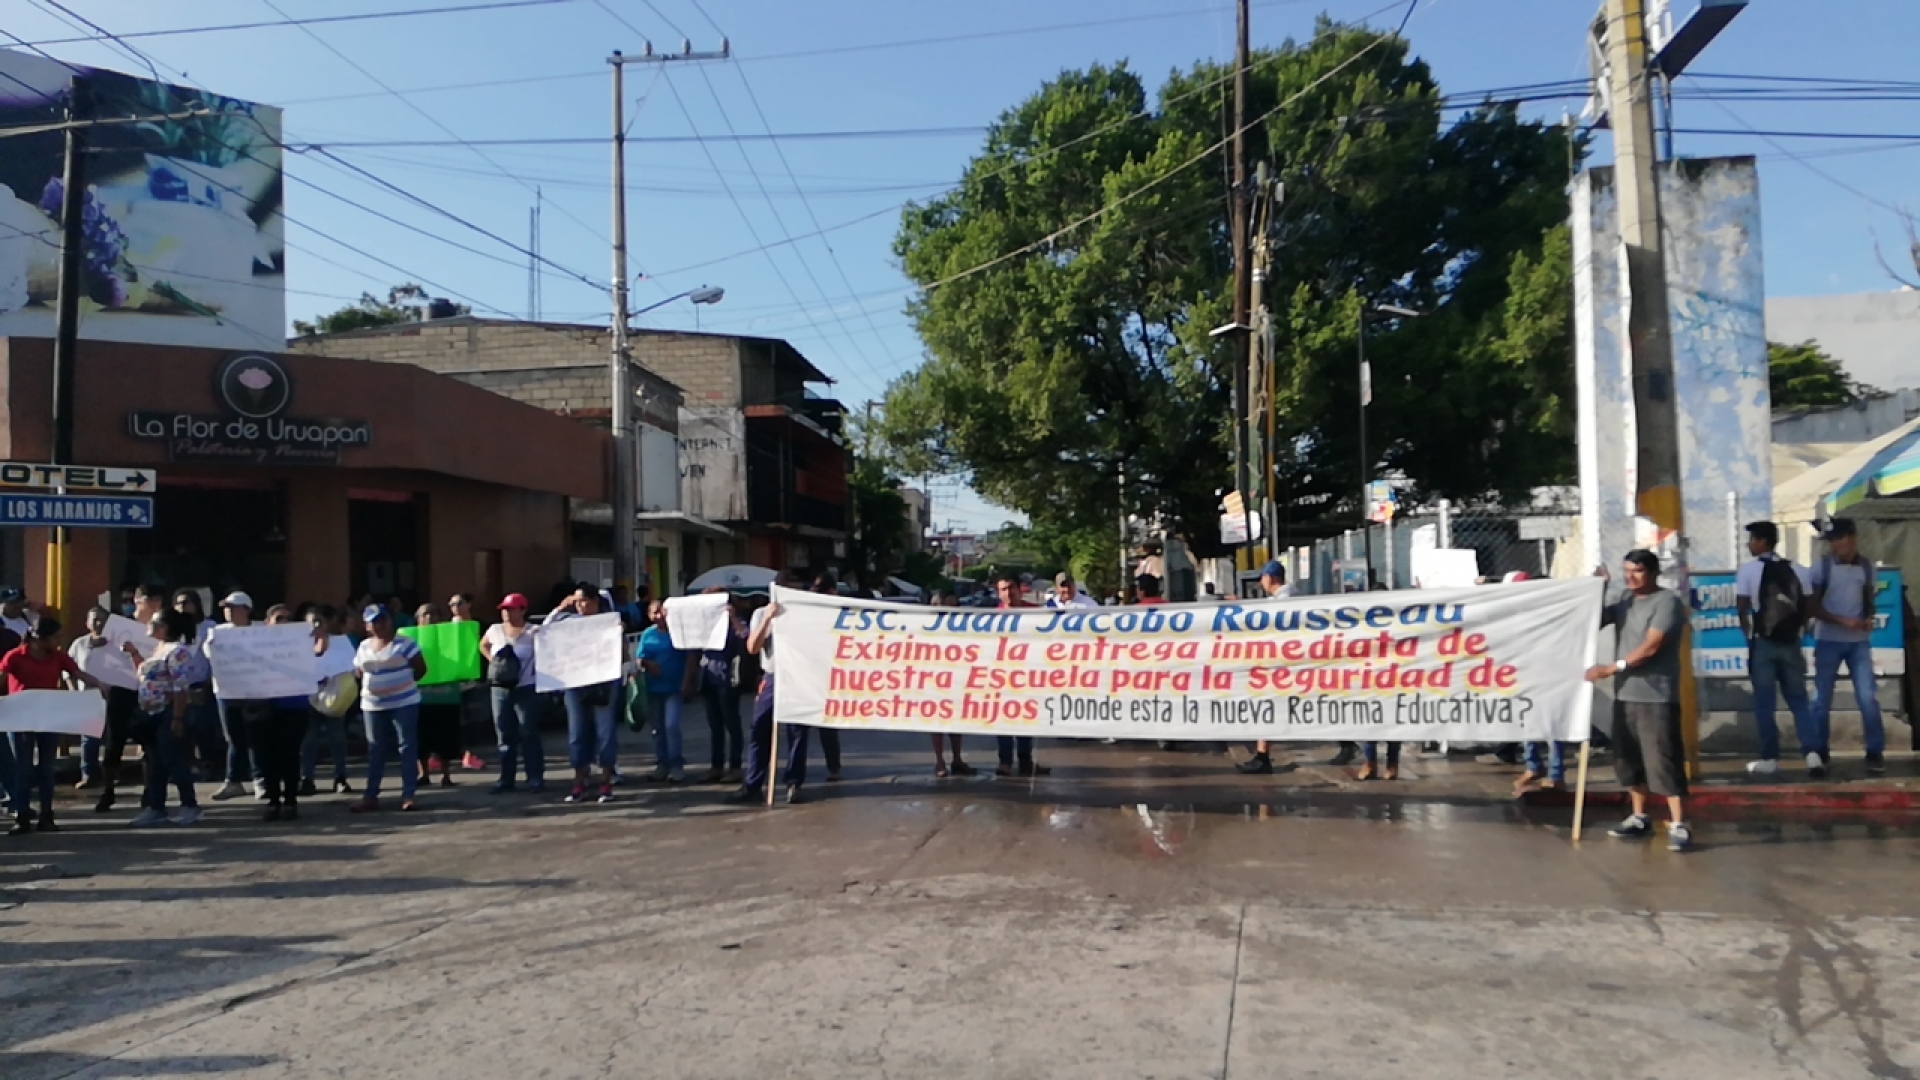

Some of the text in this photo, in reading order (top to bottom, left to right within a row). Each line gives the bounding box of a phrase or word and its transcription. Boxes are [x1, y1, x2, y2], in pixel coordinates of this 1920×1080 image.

[134, 413, 368, 447] La Flor de Uruapan
[8, 500, 122, 520] LOS NARANJOS
[922, 610, 1021, 632] Juan
[1036, 608, 1194, 633] Jacobo
[1211, 603, 1465, 632] Rousseau
[835, 628, 1488, 664] Exigimos la entrega inmediata de
[829, 666, 953, 691] nuestra
[966, 665, 1101, 690] Escuela
[1111, 670, 1191, 693] para
[1202, 665, 1234, 690] la
[1468, 658, 1518, 688] de
[824, 695, 953, 719] nuestros
[961, 695, 1039, 724] hijos
[1130, 695, 1173, 722] esta
[1181, 694, 1198, 723] la
[1210, 700, 1274, 724] nueva
[1288, 695, 1384, 724] Reforma
[1395, 693, 1534, 728] Educativa?
